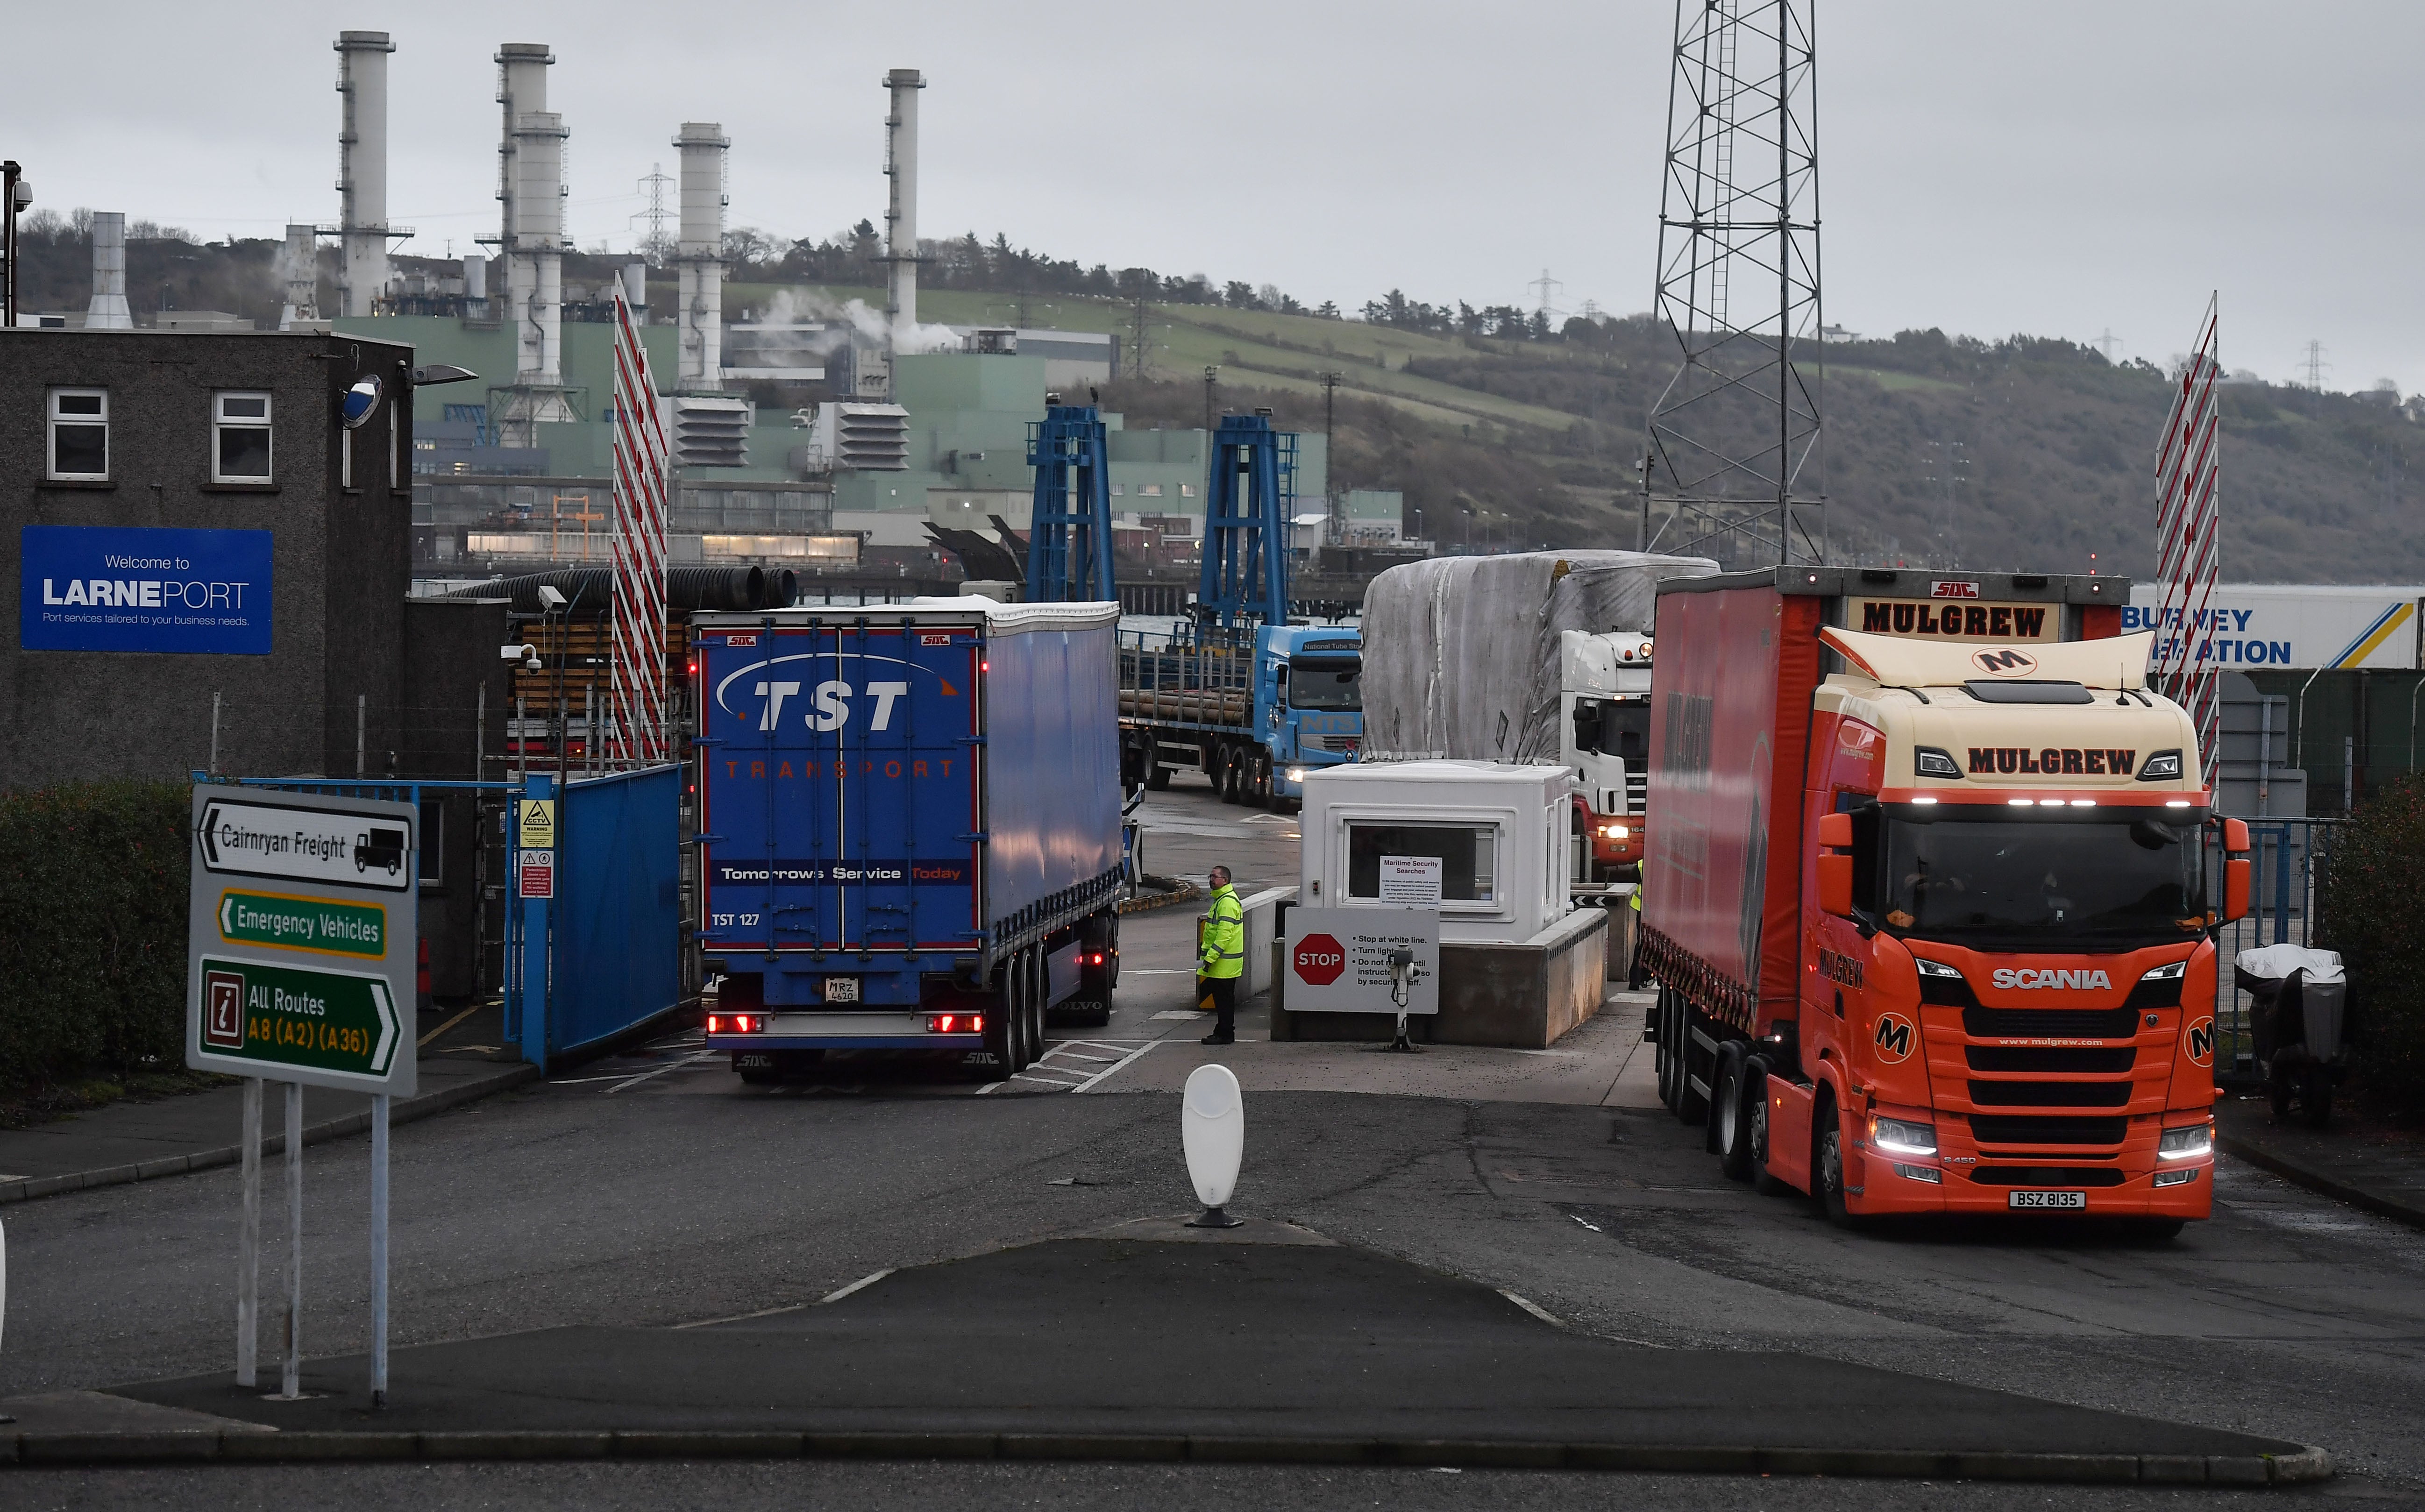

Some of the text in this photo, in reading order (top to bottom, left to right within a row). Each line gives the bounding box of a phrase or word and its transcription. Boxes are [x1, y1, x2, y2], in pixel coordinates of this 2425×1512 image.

[105, 554, 189, 570] Welcome to
[43, 578, 249, 609] LARNEPORT
[43, 612, 249, 626] Port services tailored to your business needs.
[1862, 602, 2046, 638] MULGREW
[1976, 649, 2034, 672] M
[754, 680, 911, 732] TST
[1301, 715, 1357, 731] NTS
[726, 760, 953, 779] TRANSPORT
[1968, 747, 2136, 775] MULGREW
[221, 823, 346, 861] Cairnryan Freight
[721, 867, 961, 880] Tomorrows Service Today
[237, 904, 379, 942] Emergency Vehicles
[712, 914, 760, 926] TST 127
[1358, 935, 1376, 944] Stop
[1298, 952, 1340, 966] STOP
[1819, 946, 1863, 991] MULGREW
[829, 982, 853, 992] MRZ
[1358, 978, 1367, 986] by
[1991, 968, 2112, 990] SCANIA
[249, 985, 326, 1016] All Routes
[248, 1016, 369, 1056] A8 (A2) (A36)
[1876, 1016, 1911, 1057] M
[2190, 1020, 2214, 1059] M
[2017, 1193, 2077, 1206] BSZ 8135
